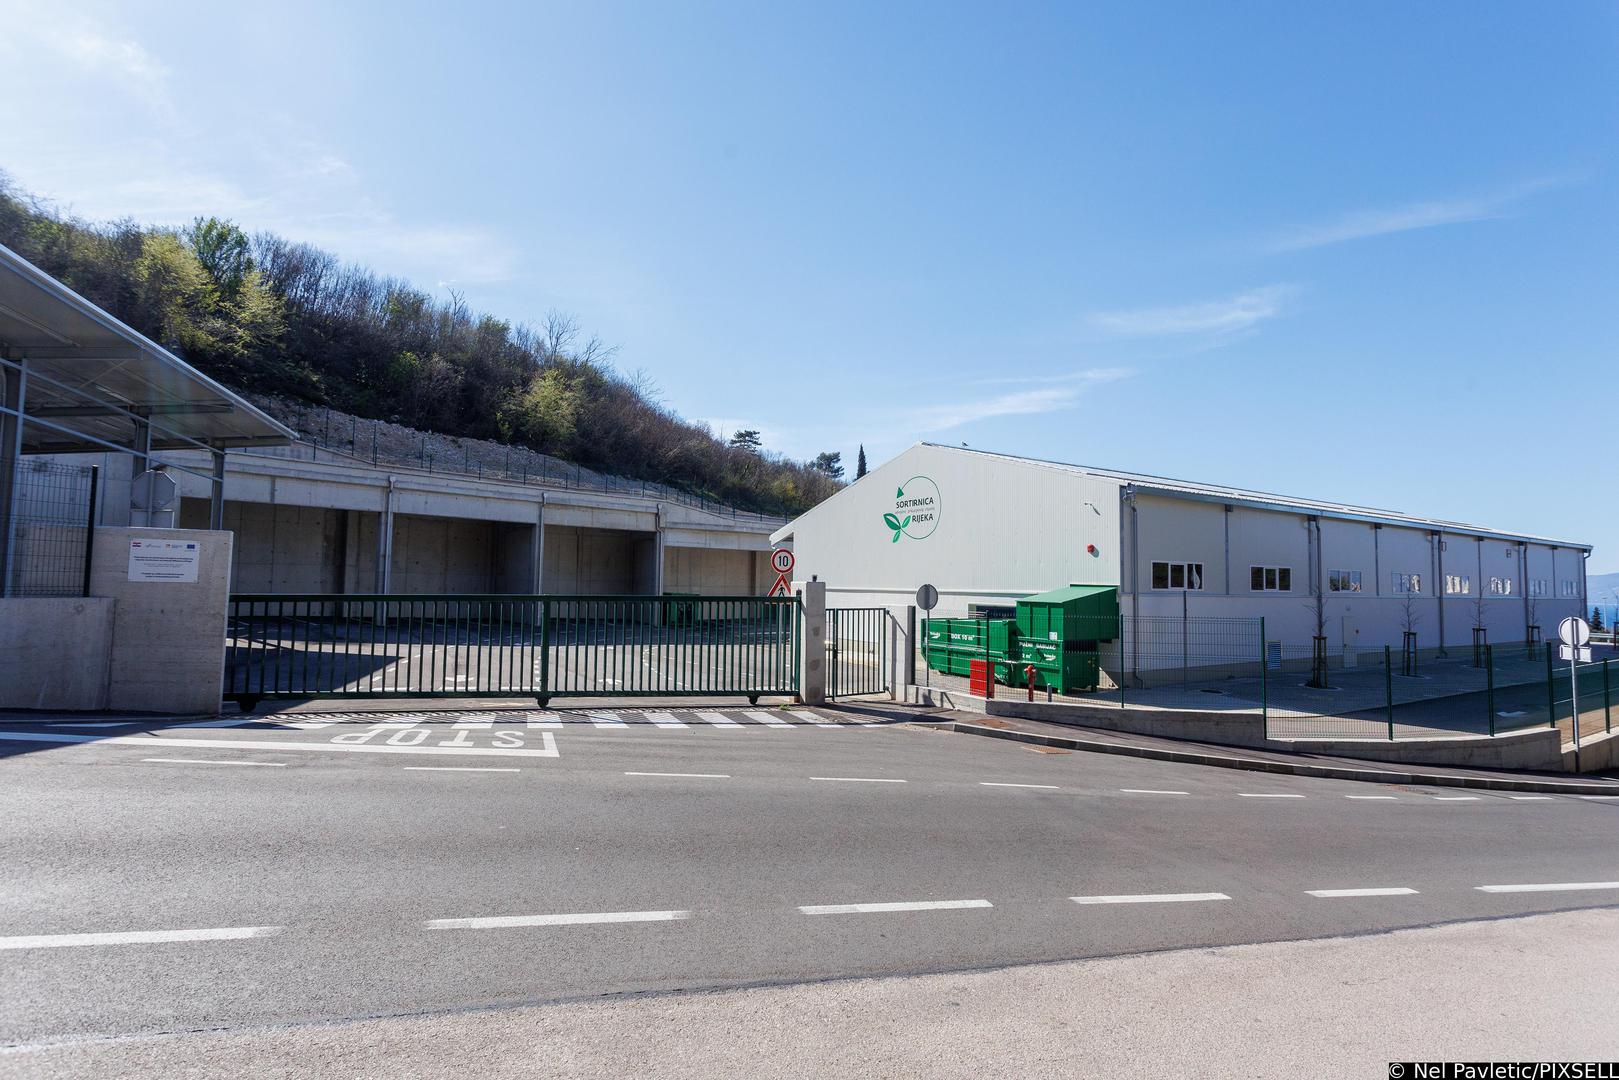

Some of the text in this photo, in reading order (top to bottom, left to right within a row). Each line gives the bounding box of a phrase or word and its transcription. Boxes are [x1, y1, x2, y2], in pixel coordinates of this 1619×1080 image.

[896, 497, 934, 509] SORTIRNICA
[912, 513, 934, 523] RIJEKA
[778, 555, 789, 567] 10
[330, 729, 524, 748] STOP
